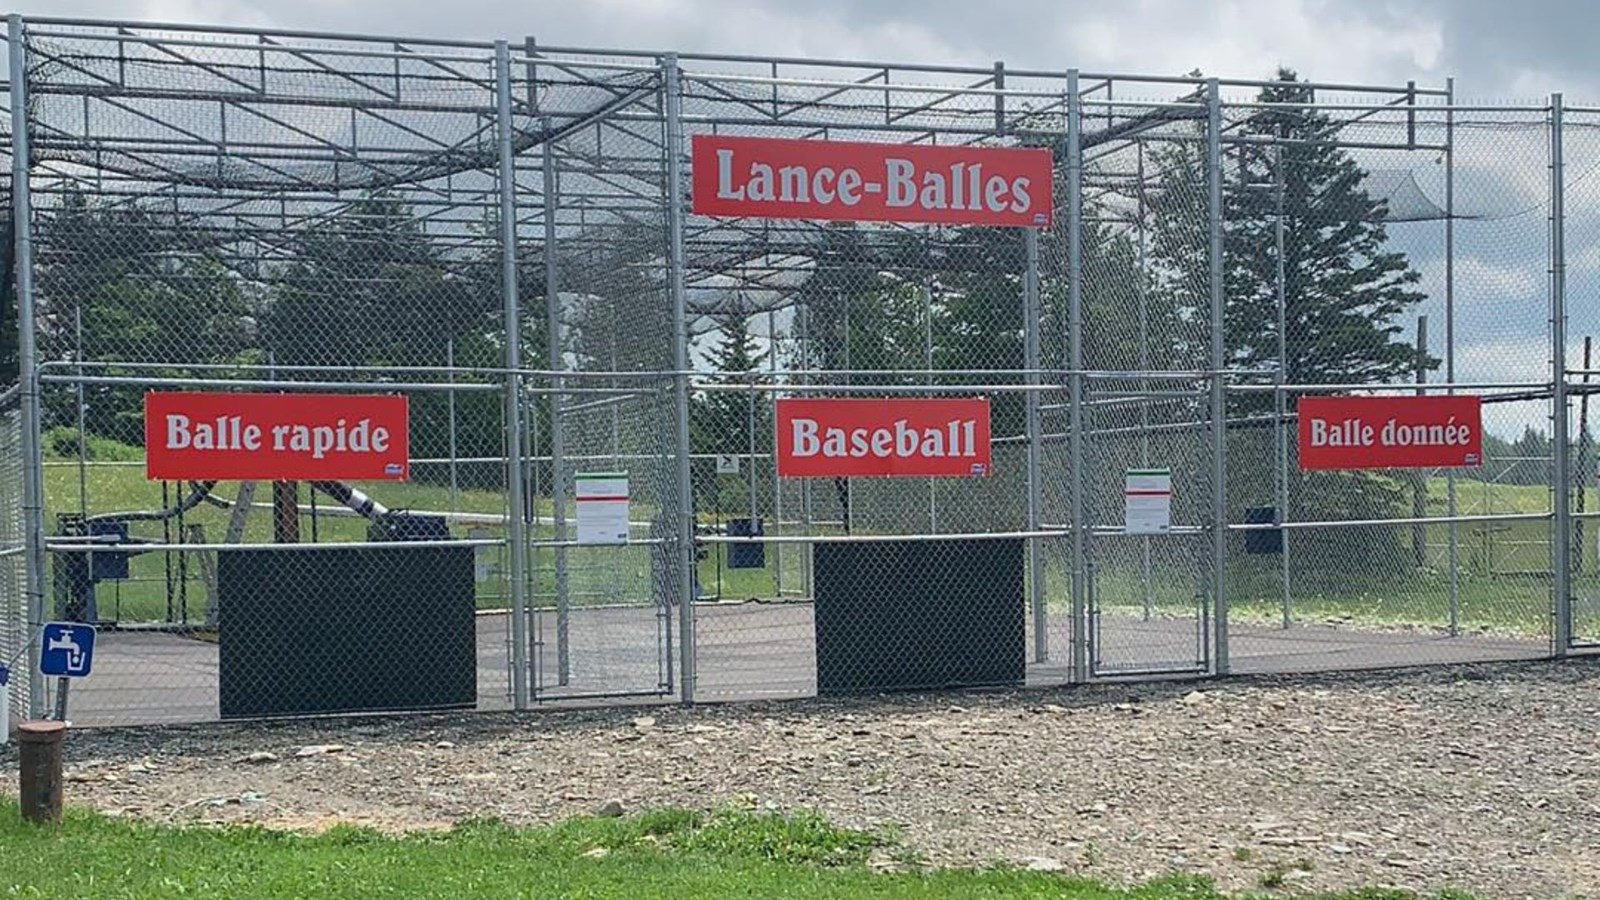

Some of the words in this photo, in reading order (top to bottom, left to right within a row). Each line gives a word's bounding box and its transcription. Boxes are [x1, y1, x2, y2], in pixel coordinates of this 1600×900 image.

[717, 149, 1031, 213] Lance-Balles
[166, 414, 261, 450] Balle
[272, 419, 389, 459] rapide
[791, 419, 976, 457] Baseball
[1311, 419, 1374, 446] Balle
[1381, 416, 1469, 446] donnée
